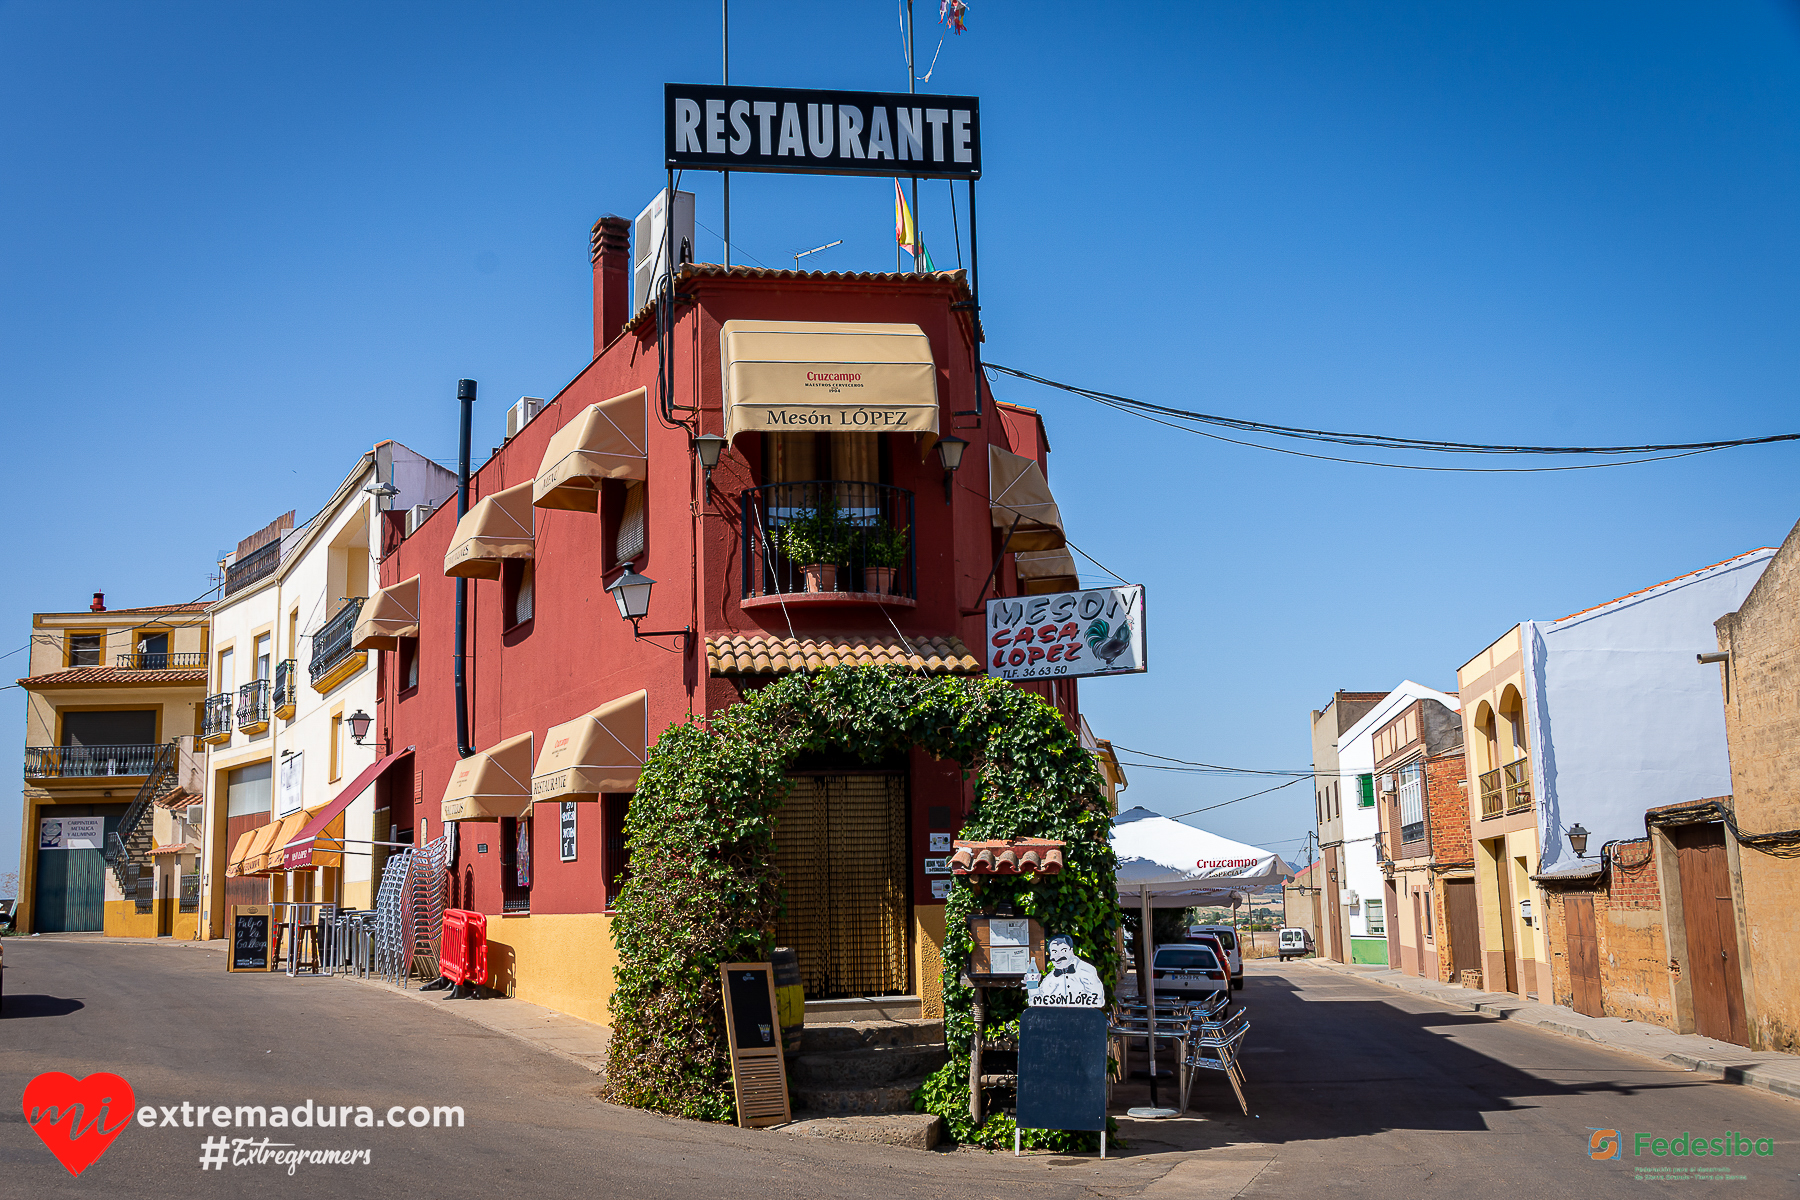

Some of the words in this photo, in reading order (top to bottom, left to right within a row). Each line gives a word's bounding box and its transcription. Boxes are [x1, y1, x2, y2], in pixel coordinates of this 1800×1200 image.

[675, 98, 973, 163] RESTAURANTE
[806, 371, 862, 383] Cruzcampo
[766, 410, 833, 426] Mesón
[839, 407, 909, 426] LÓPEZ
[991, 589, 1138, 629] MESON
[991, 622, 1081, 648] CASA
[992, 642, 1083, 669] LOPEZ
[1002, 669, 1020, 679] TLF.
[1022, 667, 1036, 678] 36
[1037, 666, 1051, 677] 63
[1053, 665, 1068, 675] 50
[1196, 858, 1258, 869] Cruzcampo
[1033, 992, 1069, 1005] MESÓN
[1069, 991, 1099, 1005] LÓPEZ
